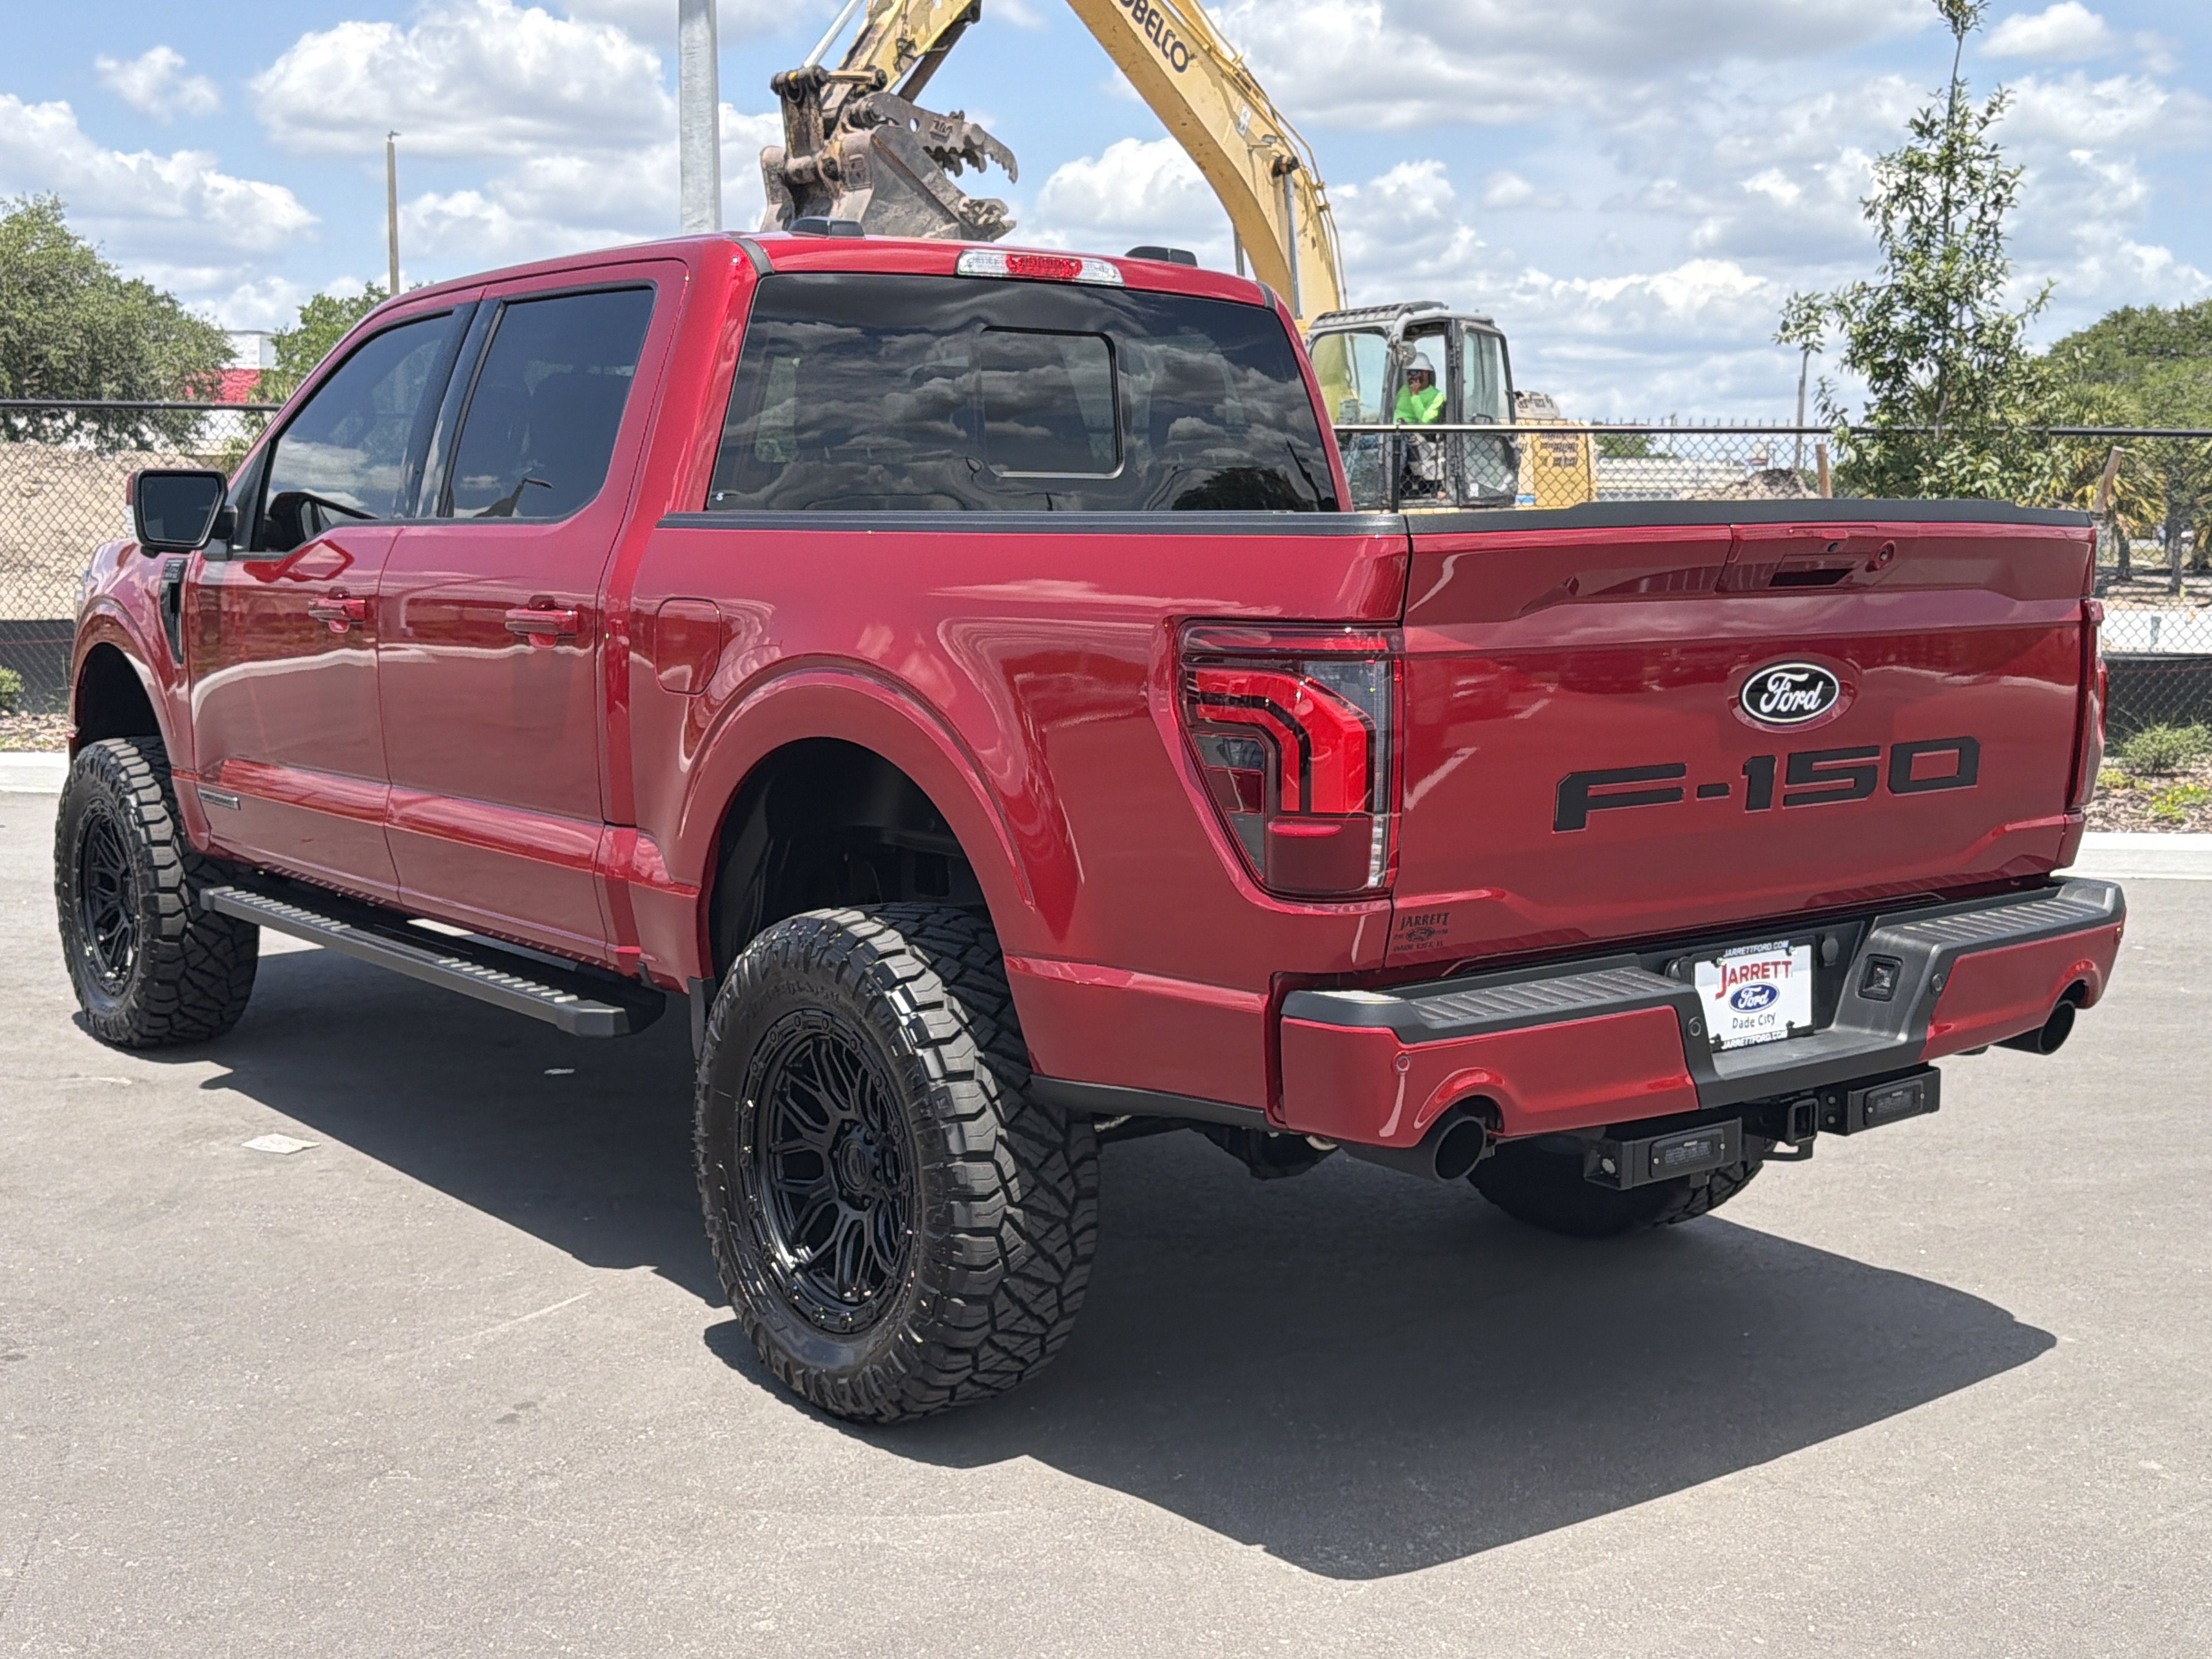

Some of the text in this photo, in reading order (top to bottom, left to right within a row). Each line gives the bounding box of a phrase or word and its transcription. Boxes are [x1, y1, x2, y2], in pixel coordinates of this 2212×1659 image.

[1120, 0, 1189, 73] BELCO
[1760, 672, 1824, 713] Ford
[1553, 736, 1980, 833] F-150
[1400, 912, 1450, 931] JARRETT
[1715, 961, 1792, 1000] JARRETT
[1738, 986, 1770, 1009] Ford
[1732, 1012, 1776, 1029] Dade City
